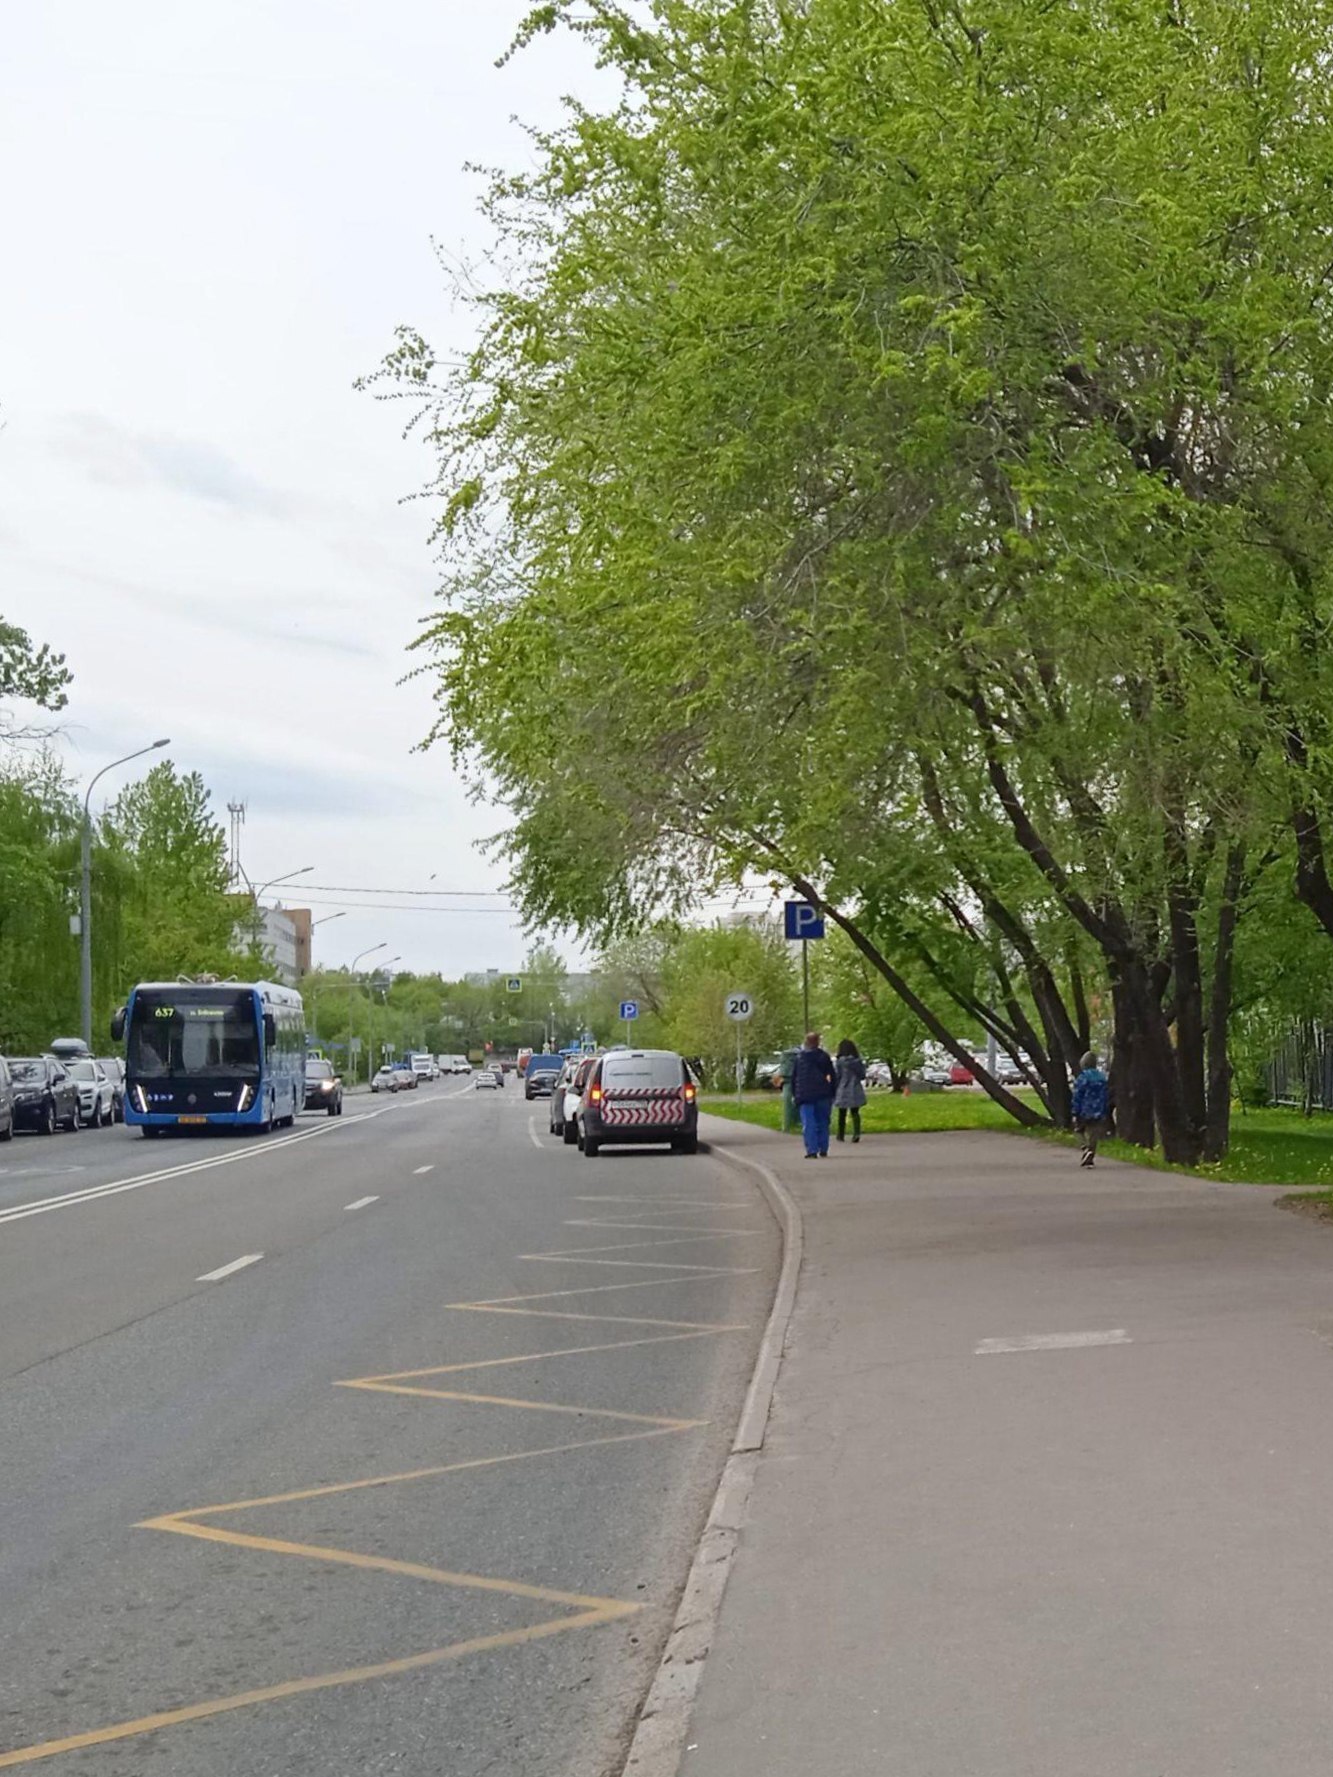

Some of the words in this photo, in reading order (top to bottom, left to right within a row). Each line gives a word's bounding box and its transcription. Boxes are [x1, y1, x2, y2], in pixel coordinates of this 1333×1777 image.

[796, 904, 817, 935] P
[155, 1008, 174, 1017] 637
[624, 1005, 636, 1017] P
[730, 1001, 749, 1014] 20
